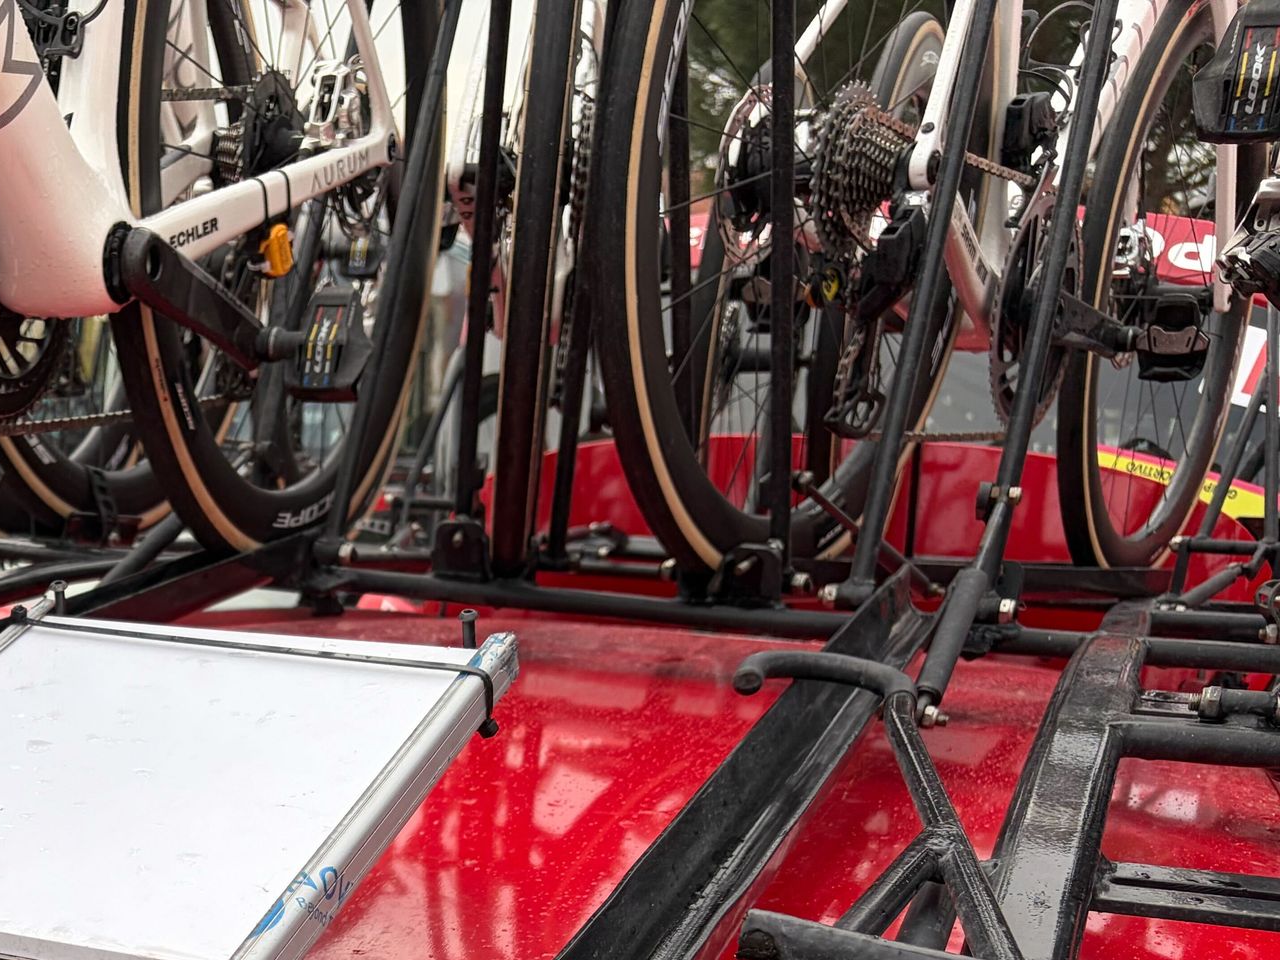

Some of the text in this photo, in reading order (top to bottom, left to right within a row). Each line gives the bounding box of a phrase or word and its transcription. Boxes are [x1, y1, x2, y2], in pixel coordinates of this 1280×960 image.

[1244, 41, 1267, 115] LOOK
[169, 216, 219, 250] ECHLER
[272, 490, 336, 529] COPE
